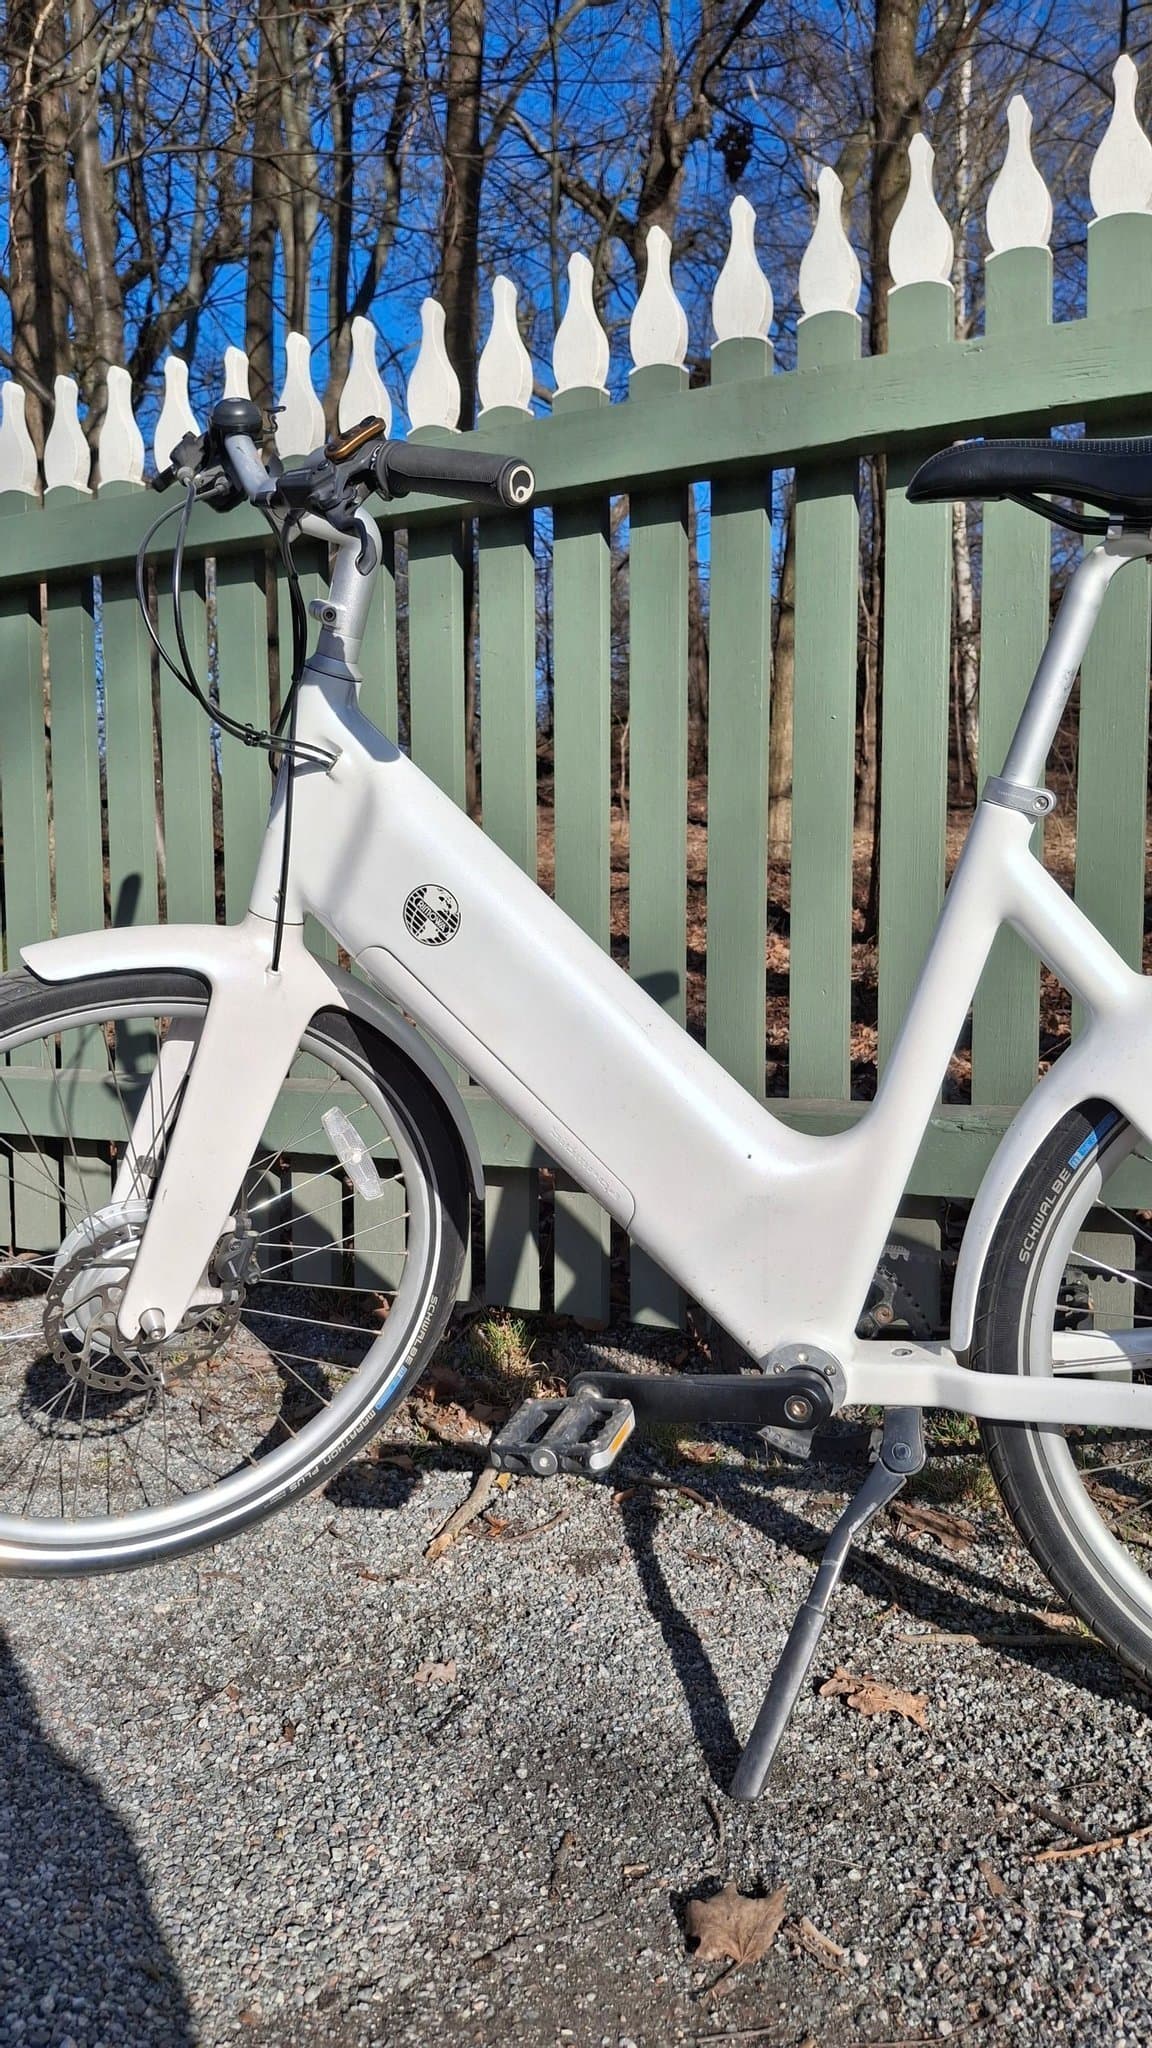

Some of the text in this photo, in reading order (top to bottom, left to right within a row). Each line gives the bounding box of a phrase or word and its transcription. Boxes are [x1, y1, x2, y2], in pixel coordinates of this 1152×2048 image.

[1019, 1168, 1071, 1264] SCHWALBE
[289, 1295, 438, 1493] SCHWALBE MARATHON PLUS
